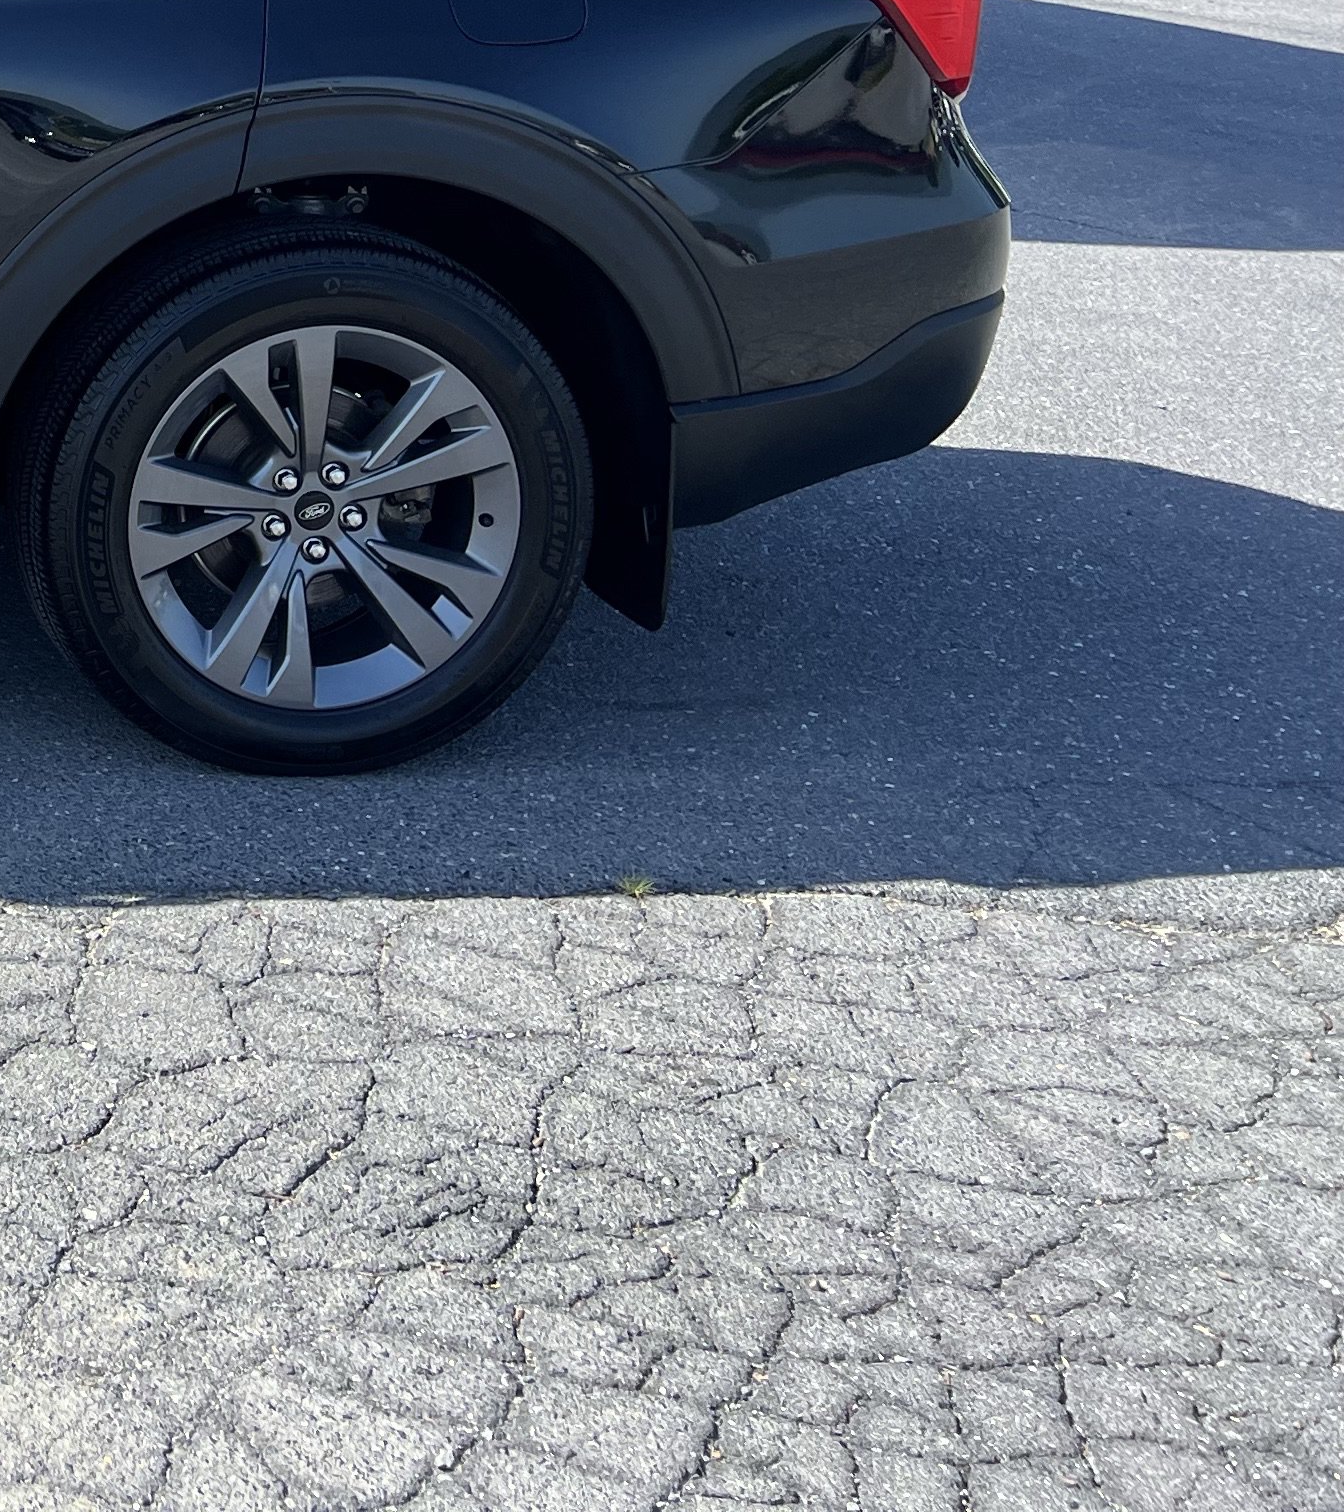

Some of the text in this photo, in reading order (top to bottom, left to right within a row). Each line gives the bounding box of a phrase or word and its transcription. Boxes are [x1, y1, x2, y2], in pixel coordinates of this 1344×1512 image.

[104, 374, 152, 450] PRIMACY
[86, 471, 120, 615] MICHELIN
[540, 428, 570, 572] MICHELIN
